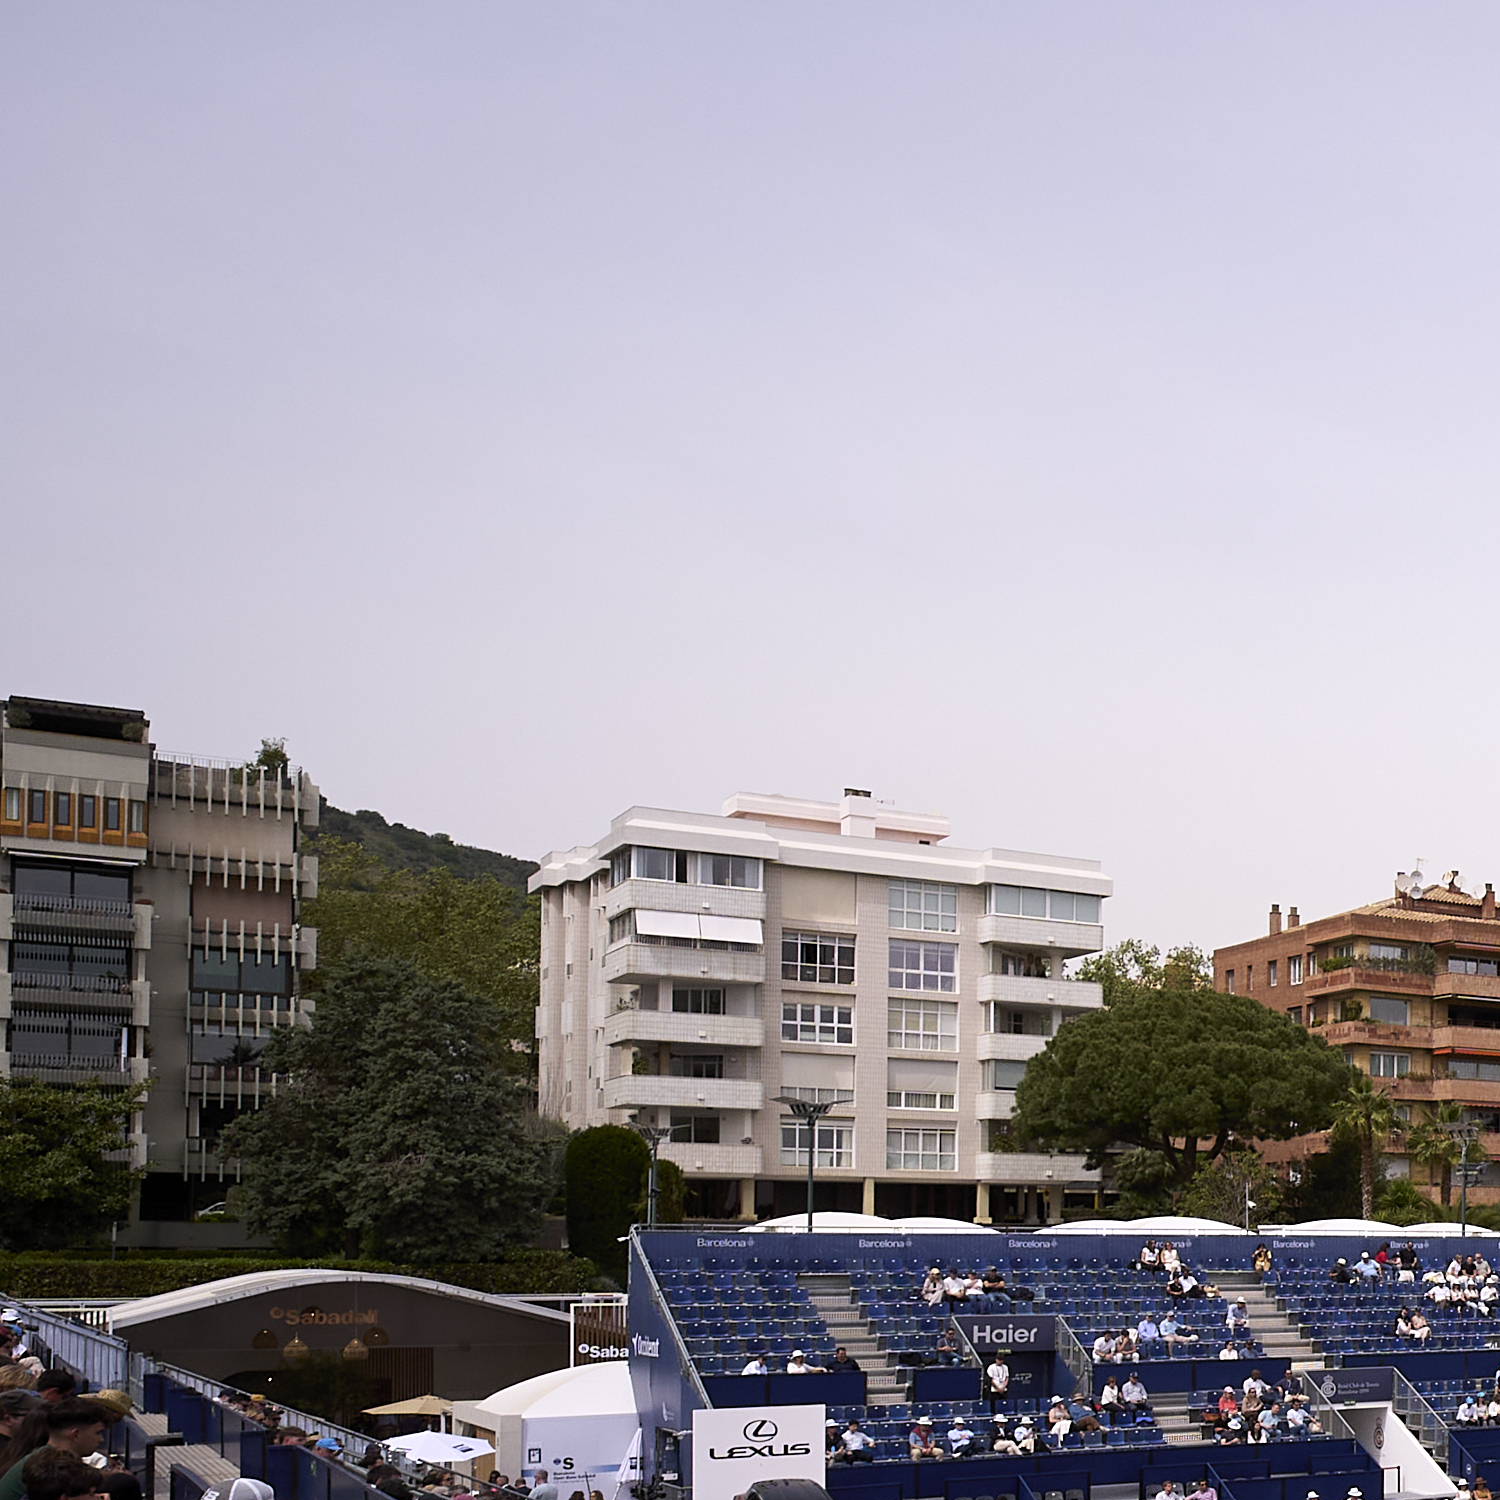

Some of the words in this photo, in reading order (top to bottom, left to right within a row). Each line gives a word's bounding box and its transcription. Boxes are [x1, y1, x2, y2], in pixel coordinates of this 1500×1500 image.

[697, 1238, 747, 1248] Barcelona
[859, 1239, 905, 1249] Barcelona
[1008, 1240, 1052, 1249] Barcelona
[1273, 1241, 1310, 1250] Barcelona
[972, 1324, 1038, 1344] Haier
[709, 1444, 812, 1460] LEXUS
